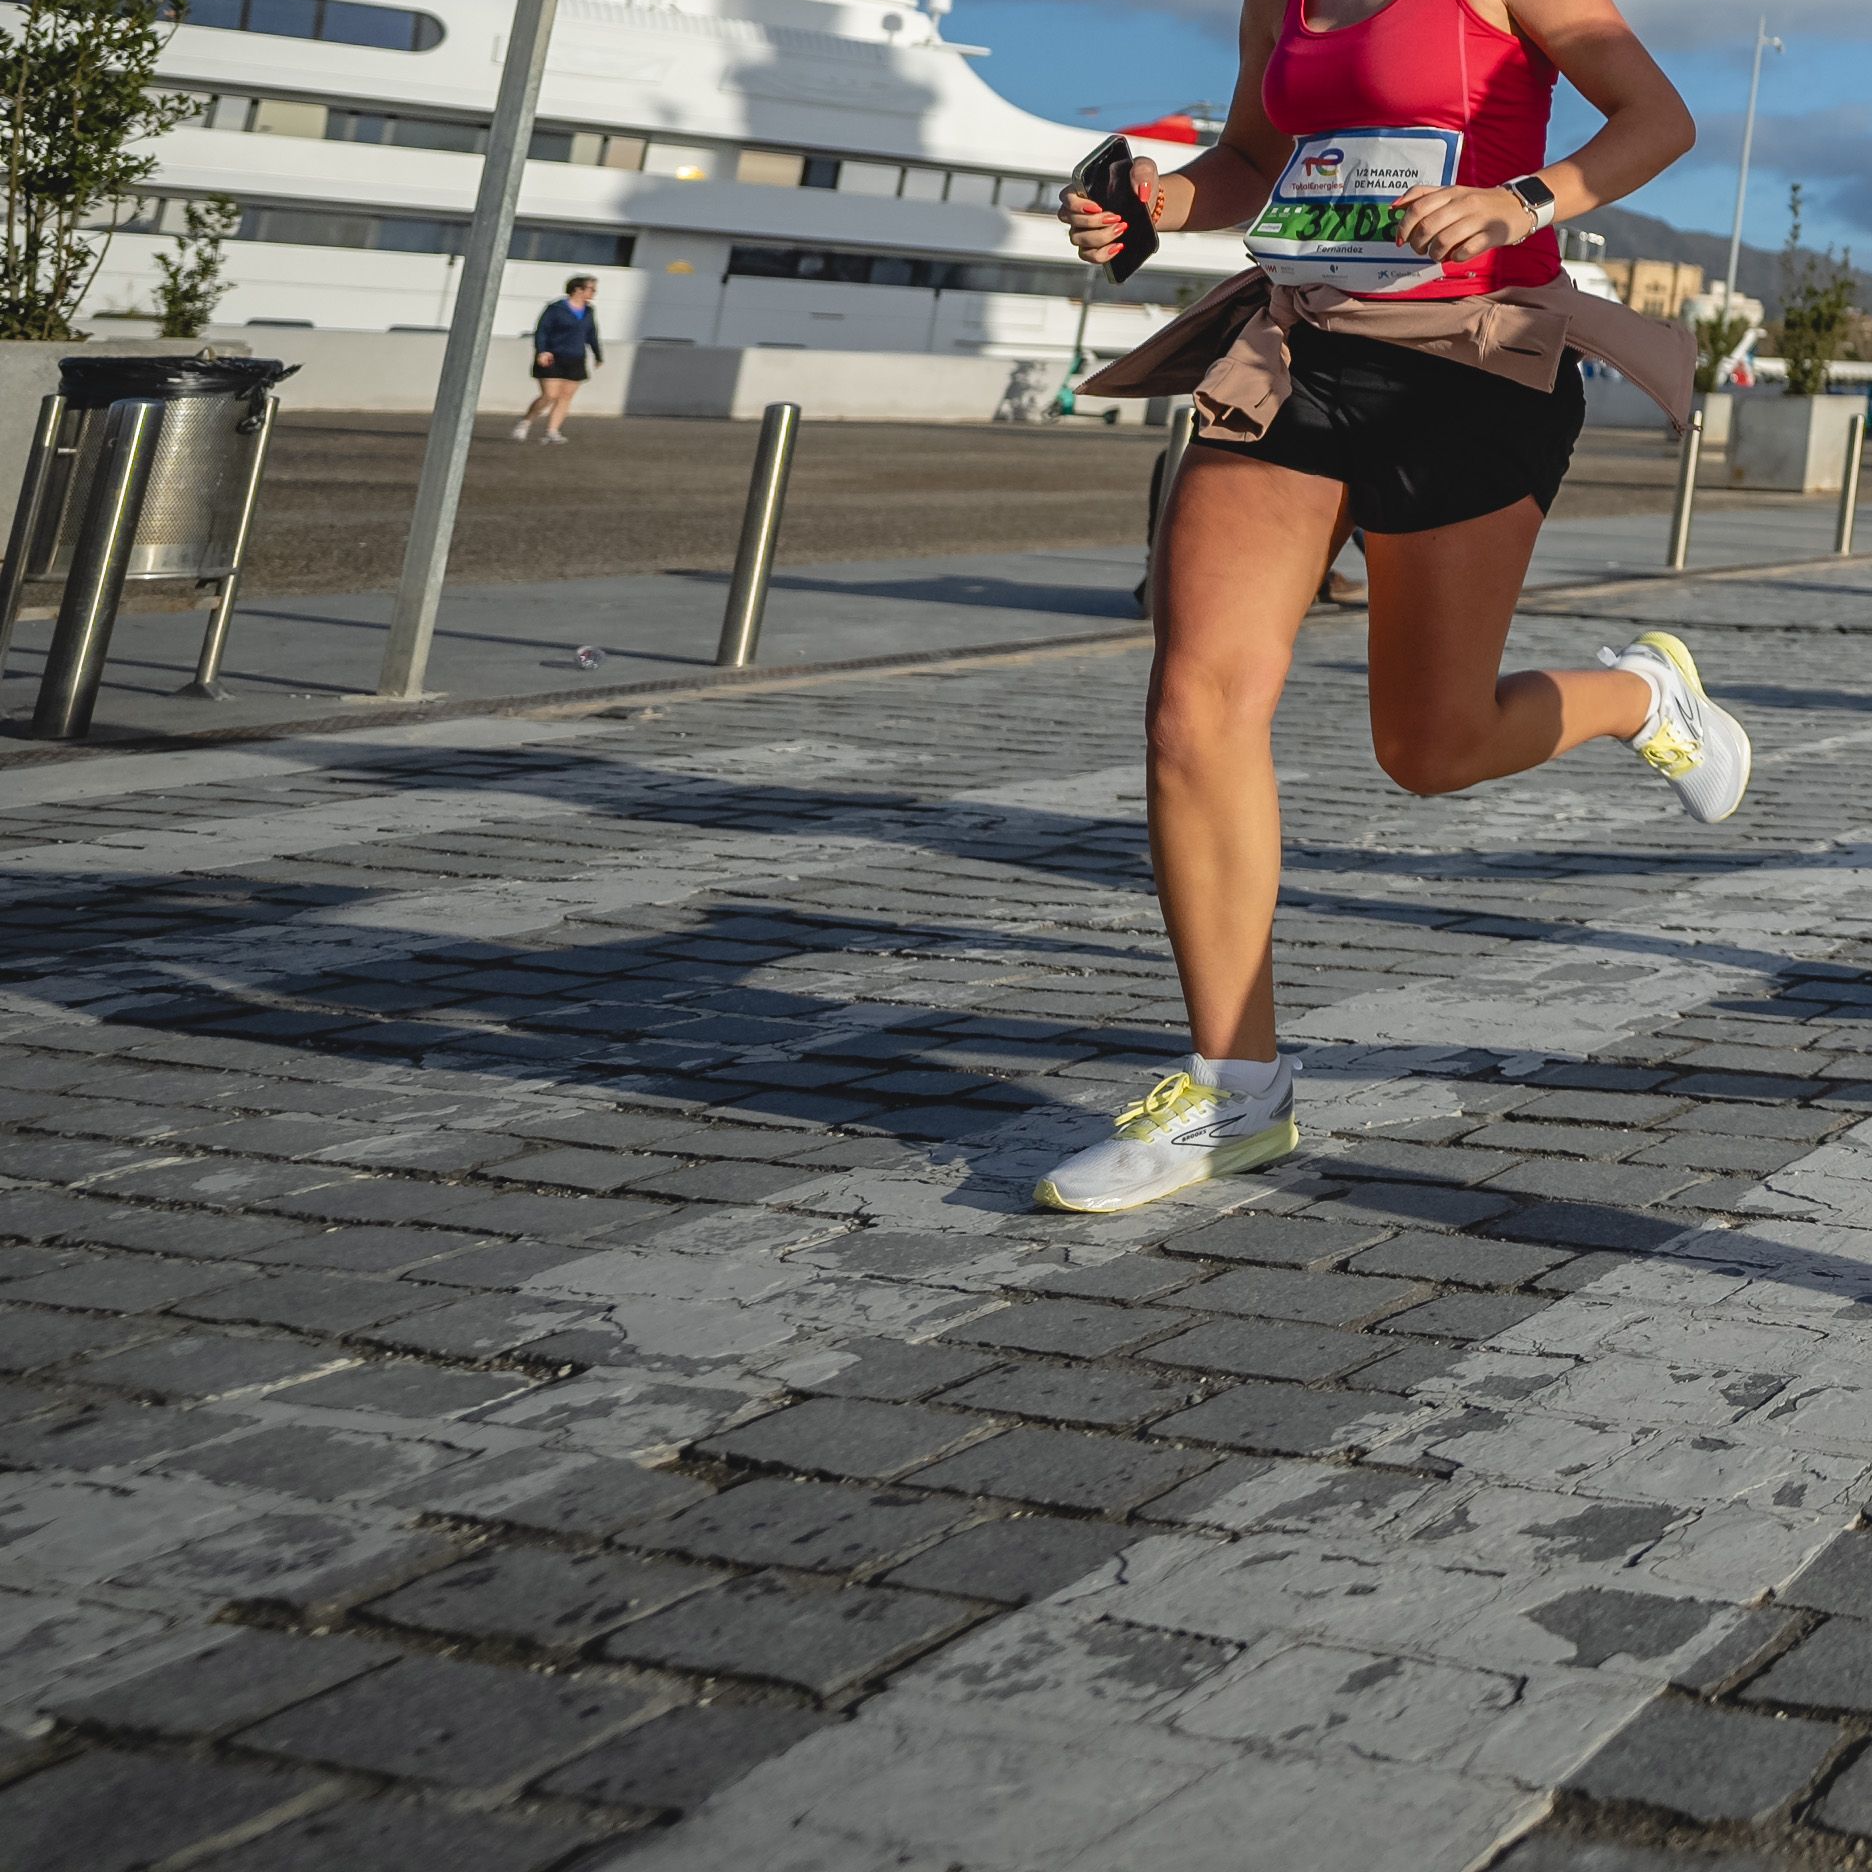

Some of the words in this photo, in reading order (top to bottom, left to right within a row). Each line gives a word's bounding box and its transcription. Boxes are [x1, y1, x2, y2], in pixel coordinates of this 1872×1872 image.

[1356, 168, 1369, 178] 1/2
[1370, 167, 1419, 178] MARATÓN
[1292, 181, 1344, 191] TotalEnergies
[1354, 180, 1367, 189] DE
[1367, 178, 1409, 189] MÁLAGA
[1296, 203, 1407, 242] 3708
